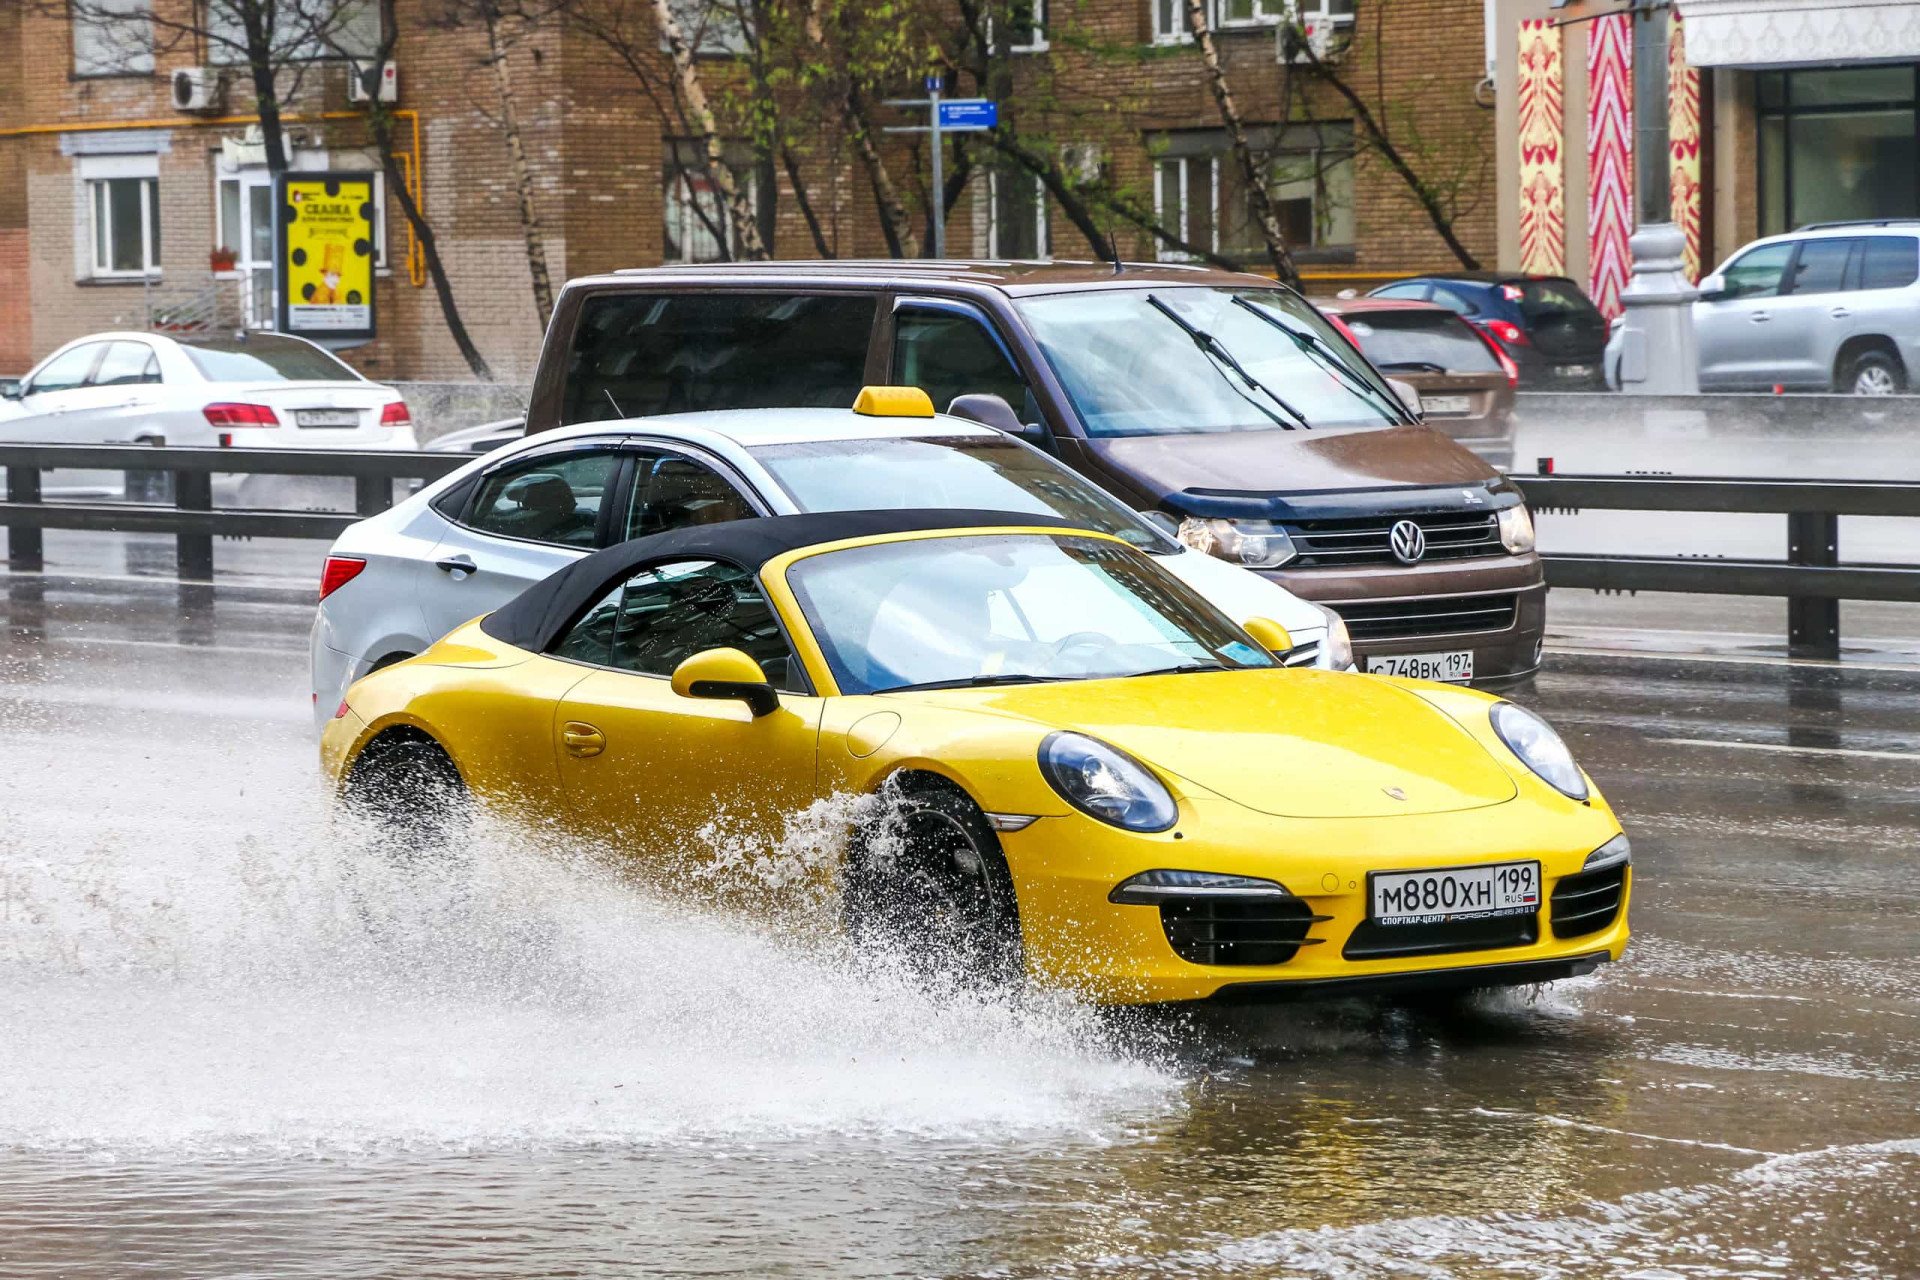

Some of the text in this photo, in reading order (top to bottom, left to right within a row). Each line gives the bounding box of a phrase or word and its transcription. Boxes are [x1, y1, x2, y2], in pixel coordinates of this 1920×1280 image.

[1446, 654, 1469, 671] 197
[1382, 867, 1532, 913] М880ХН 199
[1505, 893, 1523, 904] RUS
[1382, 914, 1446, 925] СПОРТКАР-ЦЕНТР
